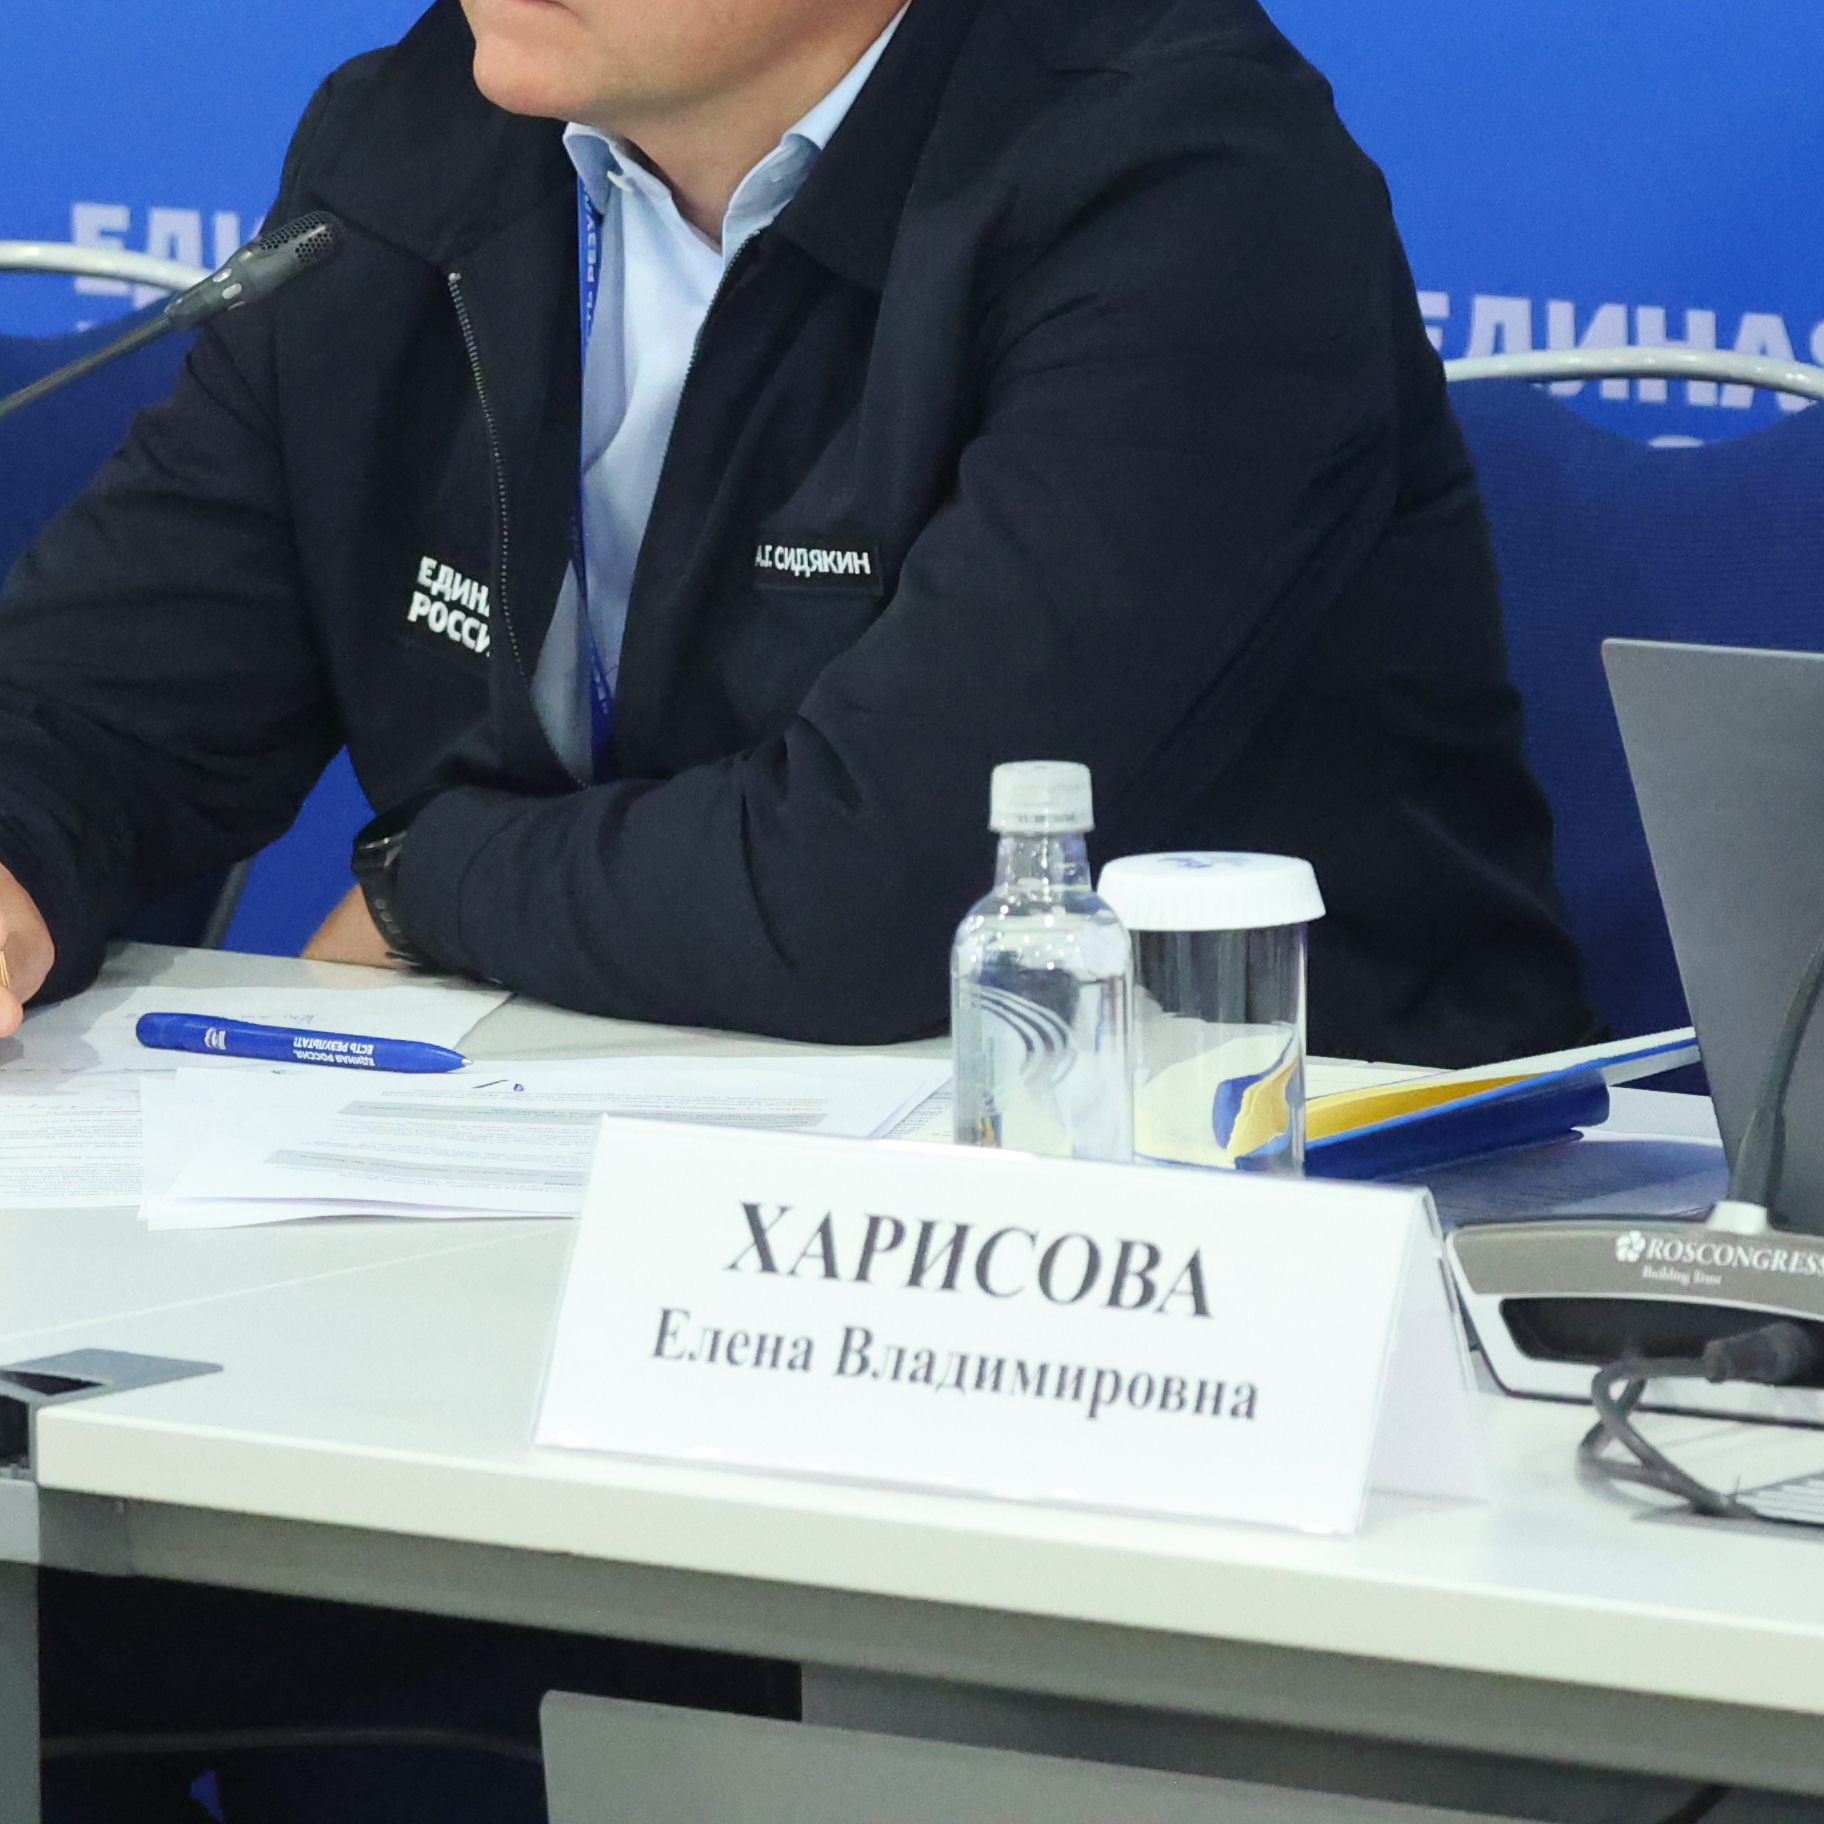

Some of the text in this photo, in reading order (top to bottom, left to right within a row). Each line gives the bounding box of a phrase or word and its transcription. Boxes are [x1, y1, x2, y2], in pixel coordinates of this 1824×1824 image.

[417, 555, 491, 619] ЕДИН
[774, 545, 872, 578] СИДЯКИН
[406, 590, 492, 658] РОССИ
[723, 1200, 1216, 1319] ХАРИСОВА
[650, 1306, 1260, 1421] Елена Владимировна
